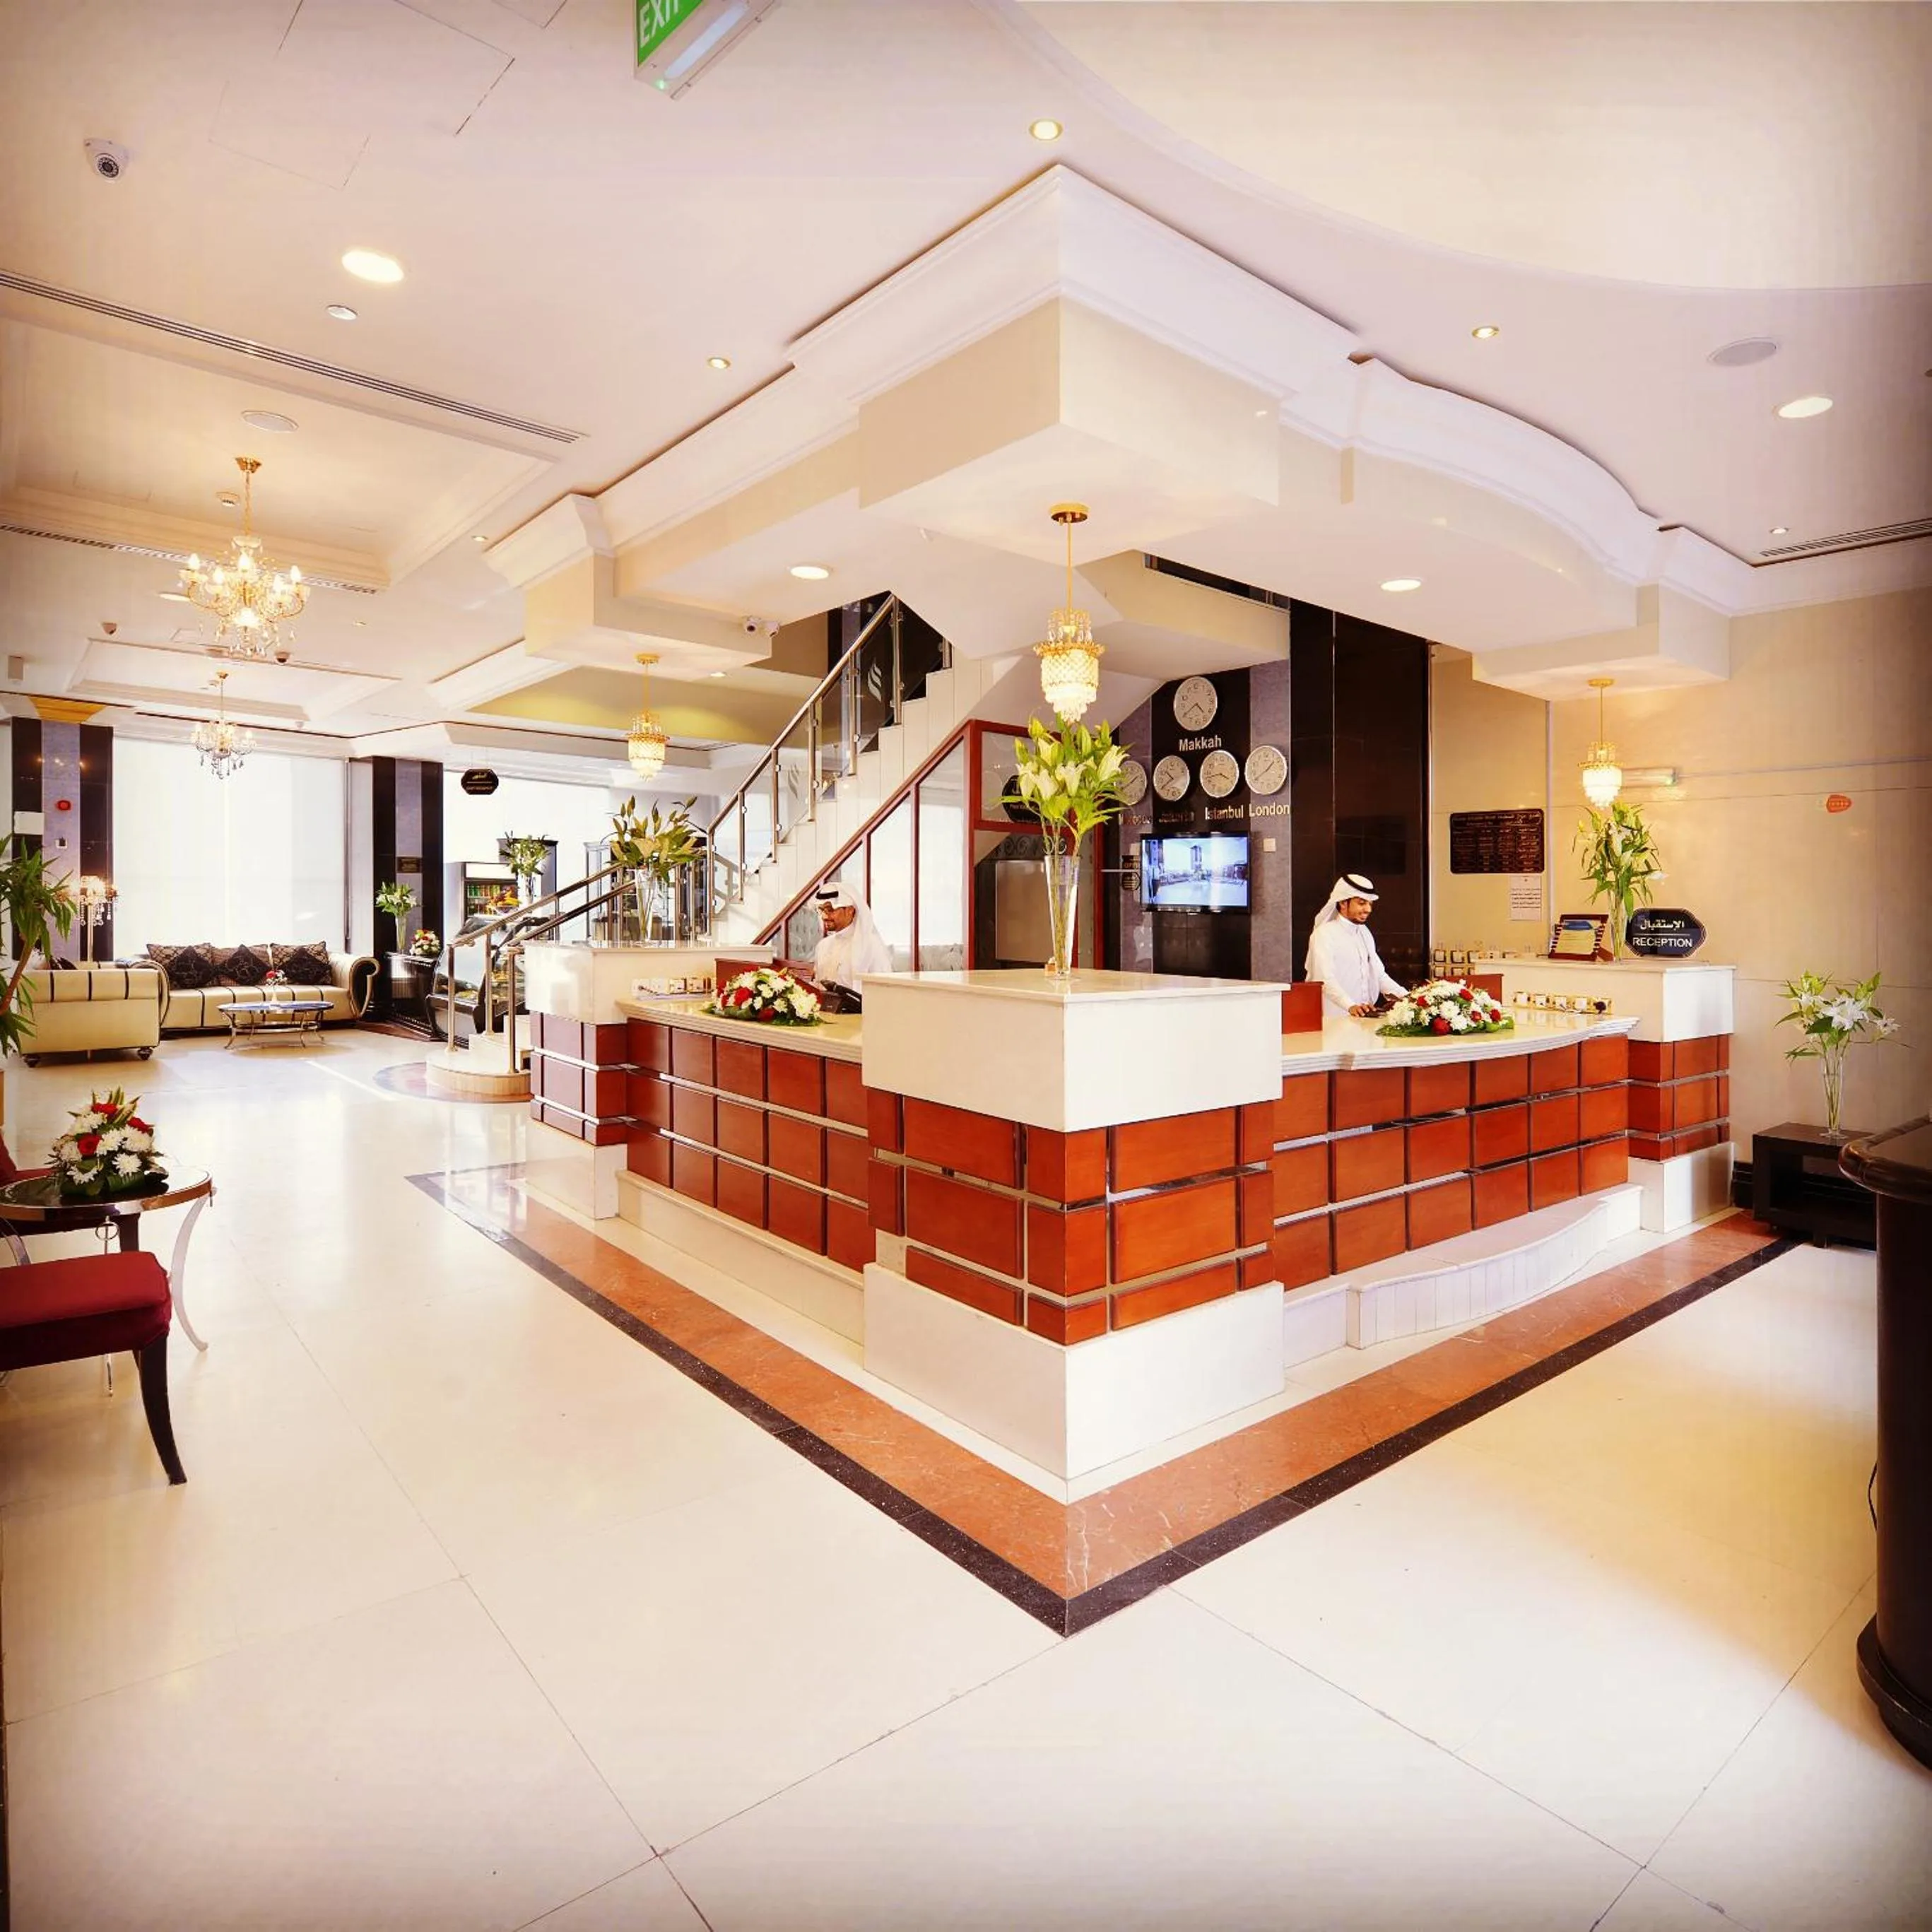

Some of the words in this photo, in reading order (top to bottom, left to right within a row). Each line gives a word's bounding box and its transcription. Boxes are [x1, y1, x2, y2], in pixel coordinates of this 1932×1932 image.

[1179, 734, 1222, 751] Makkah
[1205, 804, 1244, 820] Istanbul
[1249, 801, 1290, 816] London
[1639, 919, 1685, 931] الإستقبال
[1632, 937, 1693, 947] RECEPTION
